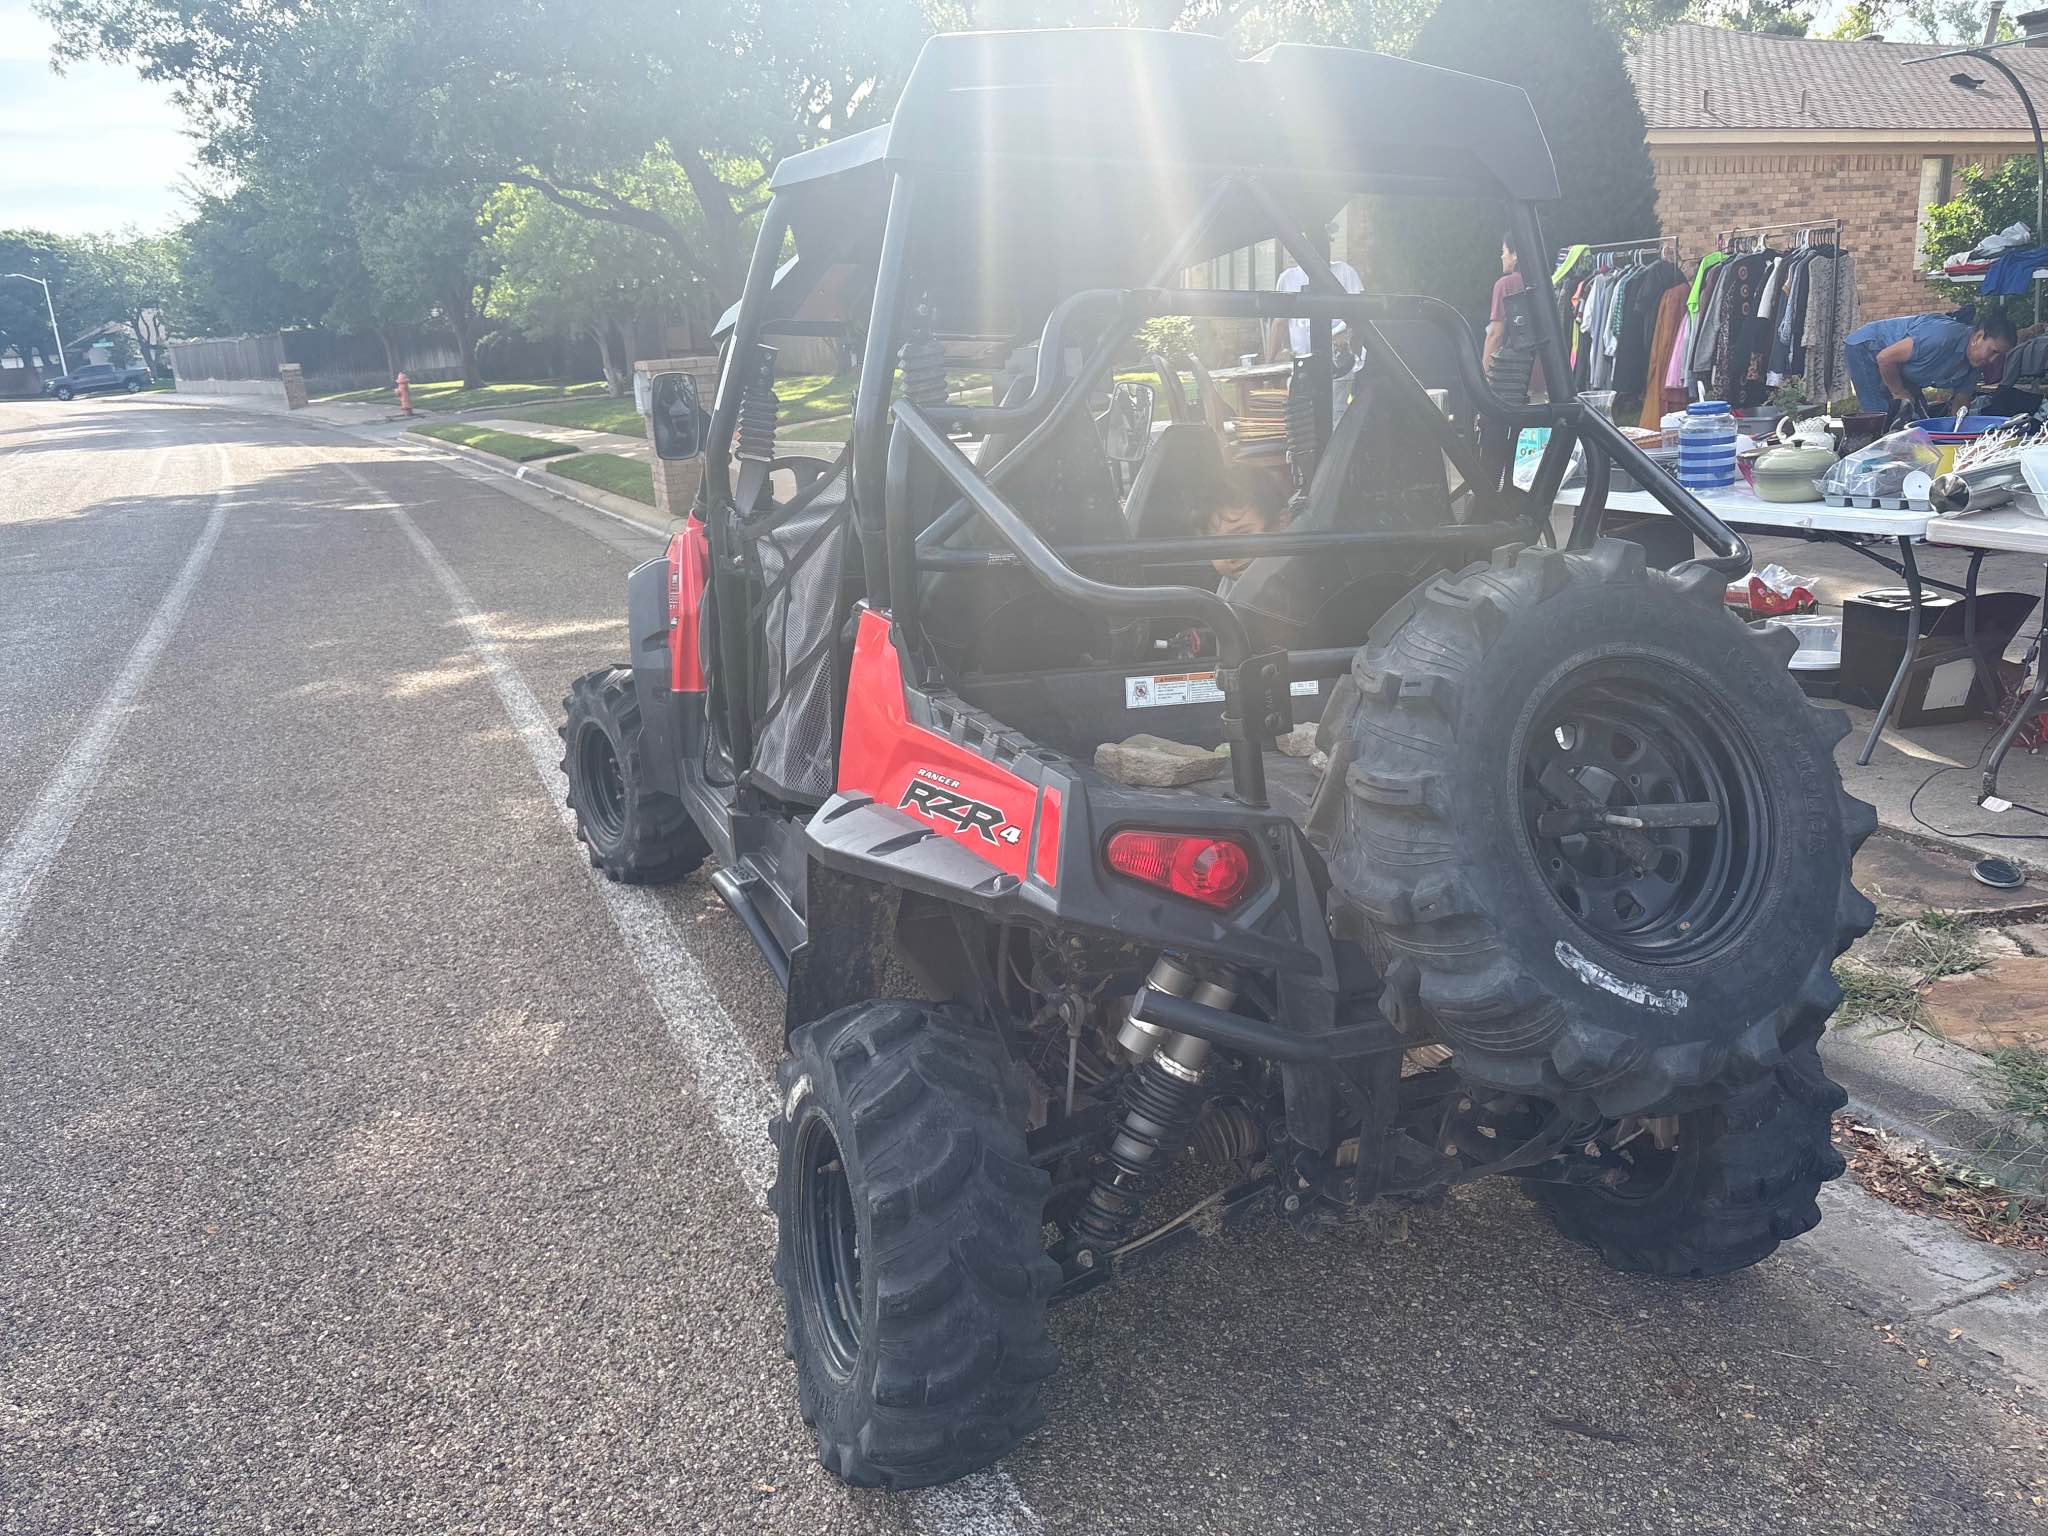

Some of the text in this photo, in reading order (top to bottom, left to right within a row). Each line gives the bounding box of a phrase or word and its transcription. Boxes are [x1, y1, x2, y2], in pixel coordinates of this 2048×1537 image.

[917, 768, 960, 788] RANGER
[897, 777, 1023, 847] RZR 4
